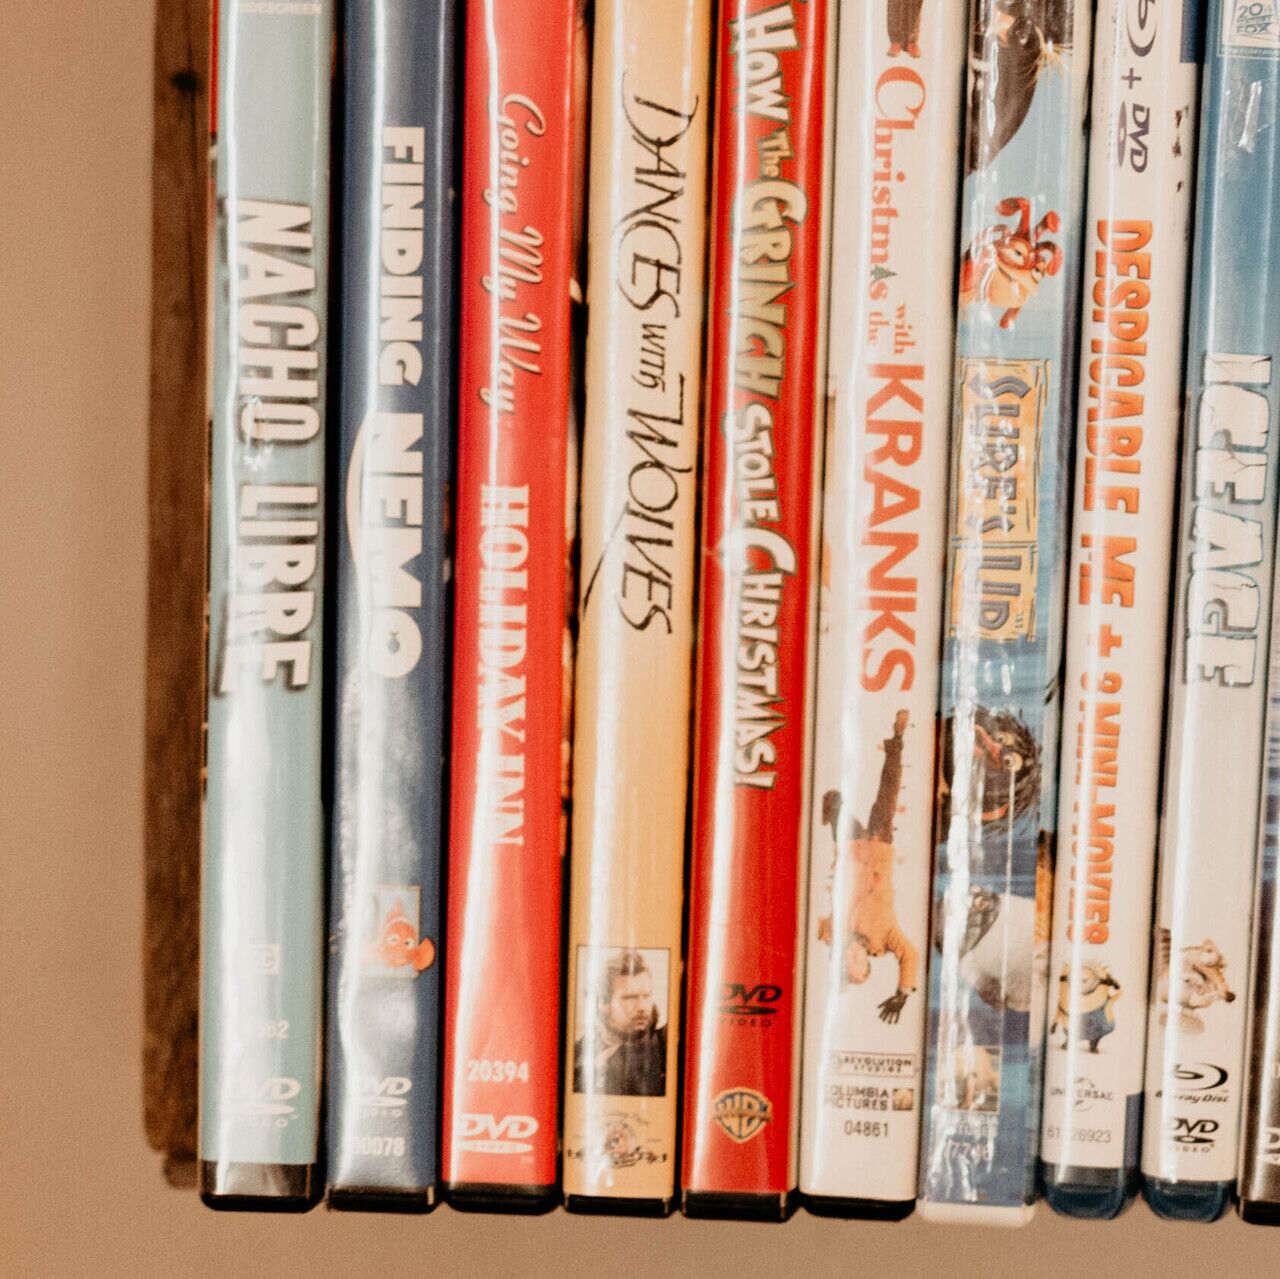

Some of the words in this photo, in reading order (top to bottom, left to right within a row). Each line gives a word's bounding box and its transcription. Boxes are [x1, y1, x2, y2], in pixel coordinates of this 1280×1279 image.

[483, 93, 547, 216] Going
[614, 68, 699, 318] DANCES
[1129, 102, 1151, 174] DVD
[379, 126, 425, 387] FINDING
[481, 226, 544, 304] My
[731, 177, 808, 401] GRINCH
[220, 198, 320, 446] NACHO
[478, 313, 542, 414] Way
[867, 311, 891, 346] the
[894, 304, 918, 355] with
[1083, 218, 1154, 515] DESPICABLE
[721, 399, 781, 524] STOLE
[1196, 352, 1272, 506] ICE
[360, 412, 424, 679] NEMO
[594, 374, 692, 634] WOLVES
[860, 363, 925, 693] KRANKS
[219, 485, 318, 698] LIBRE
[478, 484, 530, 741] HOLIDAY
[975, 554, 1021, 633] UP
[1078, 534, 1137, 609] ME
[1182, 507, 1266, 689] AGE
[719, 523, 797, 790] CHRISTMAS!
[479, 753, 525, 846] INN
[720, 983, 783, 1004] DVD
[455, 1113, 538, 1140] DVD
[466, 1059, 529, 1083] 20394
[844, 1120, 889, 1137] 04861
